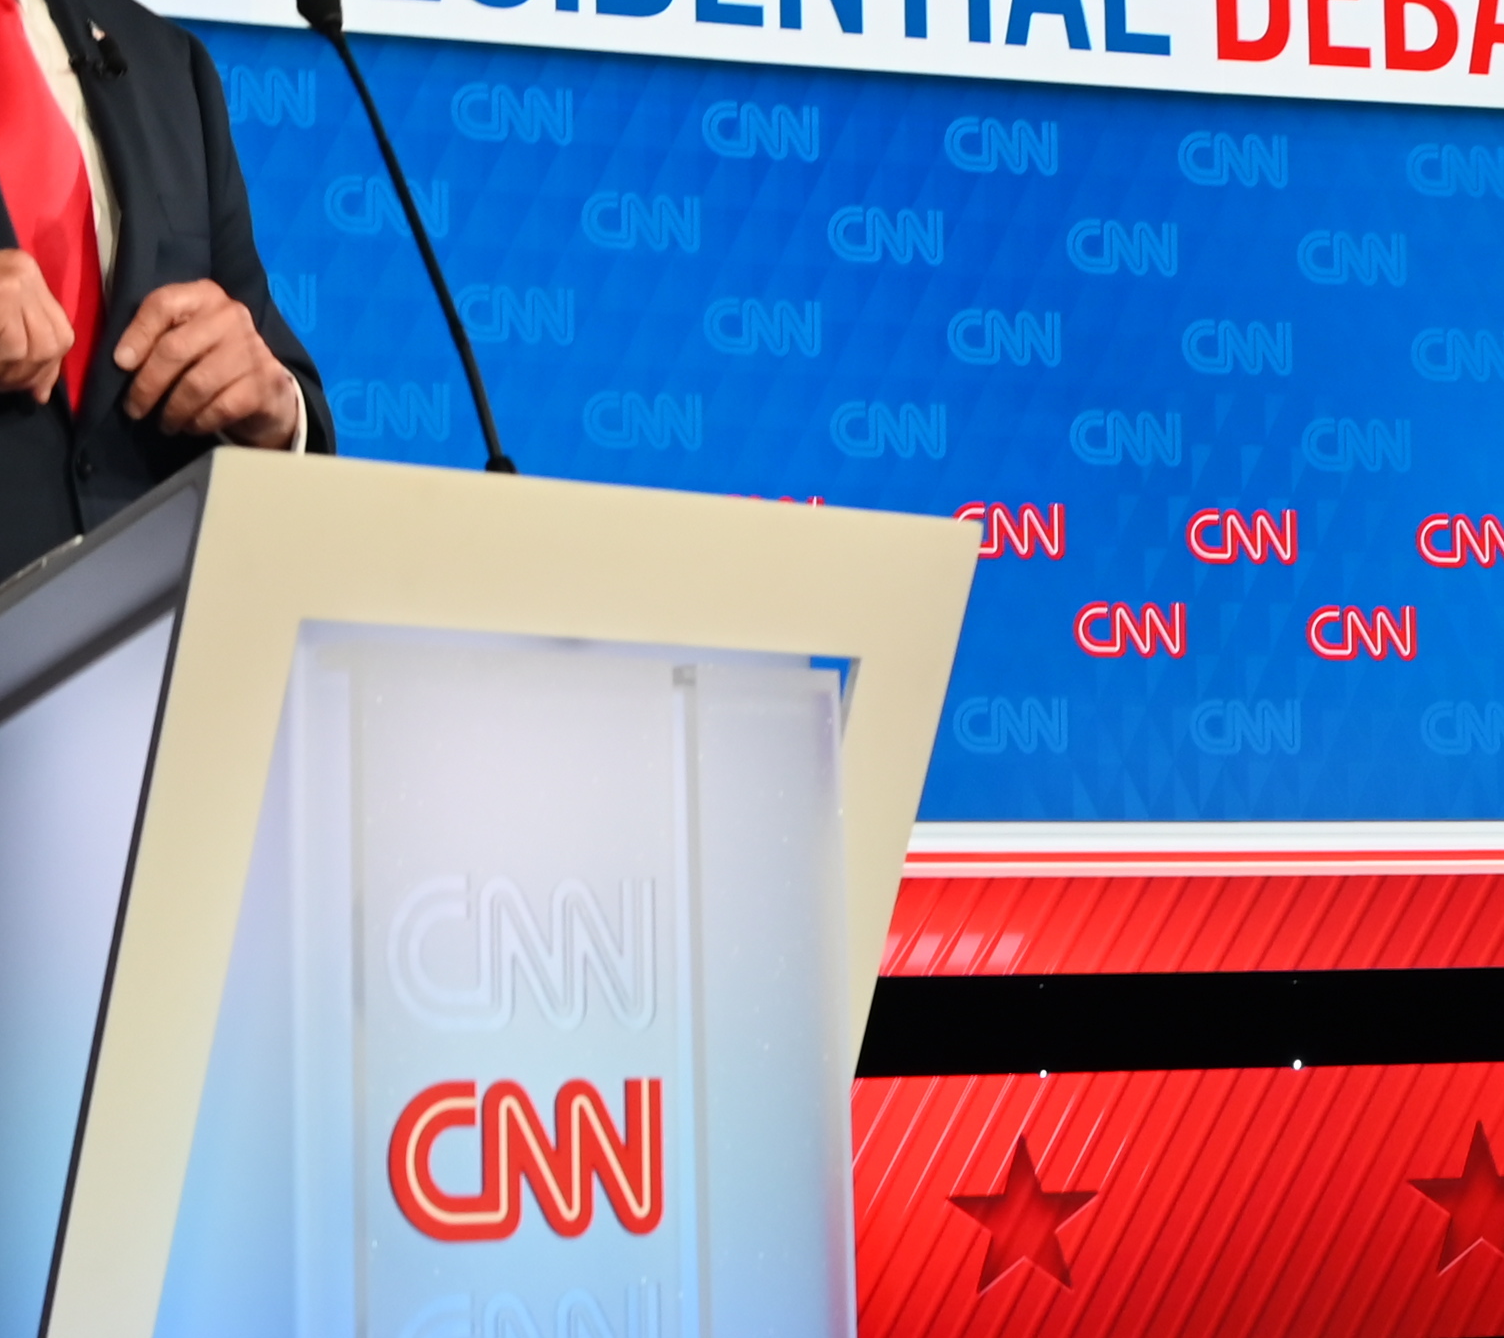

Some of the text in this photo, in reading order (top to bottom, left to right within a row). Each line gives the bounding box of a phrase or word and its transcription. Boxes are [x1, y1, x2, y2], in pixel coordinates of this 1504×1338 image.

[221, 64, 316, 129] NN
[451, 82, 574, 145] CNN
[702, 100, 819, 163] CNN
[944, 117, 1059, 177] CNN
[1177, 131, 1289, 189] CNN
[324, 174, 449, 240] CNN
[582, 191, 698, 252] CNN
[828, 206, 943, 265] CNN
[1066, 220, 1177, 277] CNN
[1299, 231, 1407, 288] CNN
[704, 298, 822, 359] CNN
[948, 309, 1062, 368] CNN
[1182, 320, 1293, 377] CNN
[333, 381, 451, 443] CNN
[584, 392, 702, 452] CNN
[830, 401, 946, 460] CNN
[1069, 409, 1182, 467] CNN
[1301, 417, 1411, 474] CNN
[1186, 508, 1296, 564] CNN
[1073, 601, 1186, 659] CNN
[1306, 605, 1416, 661] CNN
[954, 697, 1069, 755] CNN
[1189, 700, 1299, 756] CNN
[387, 873, 658, 1032] CNN
[388, 1078, 662, 1242] CNN
